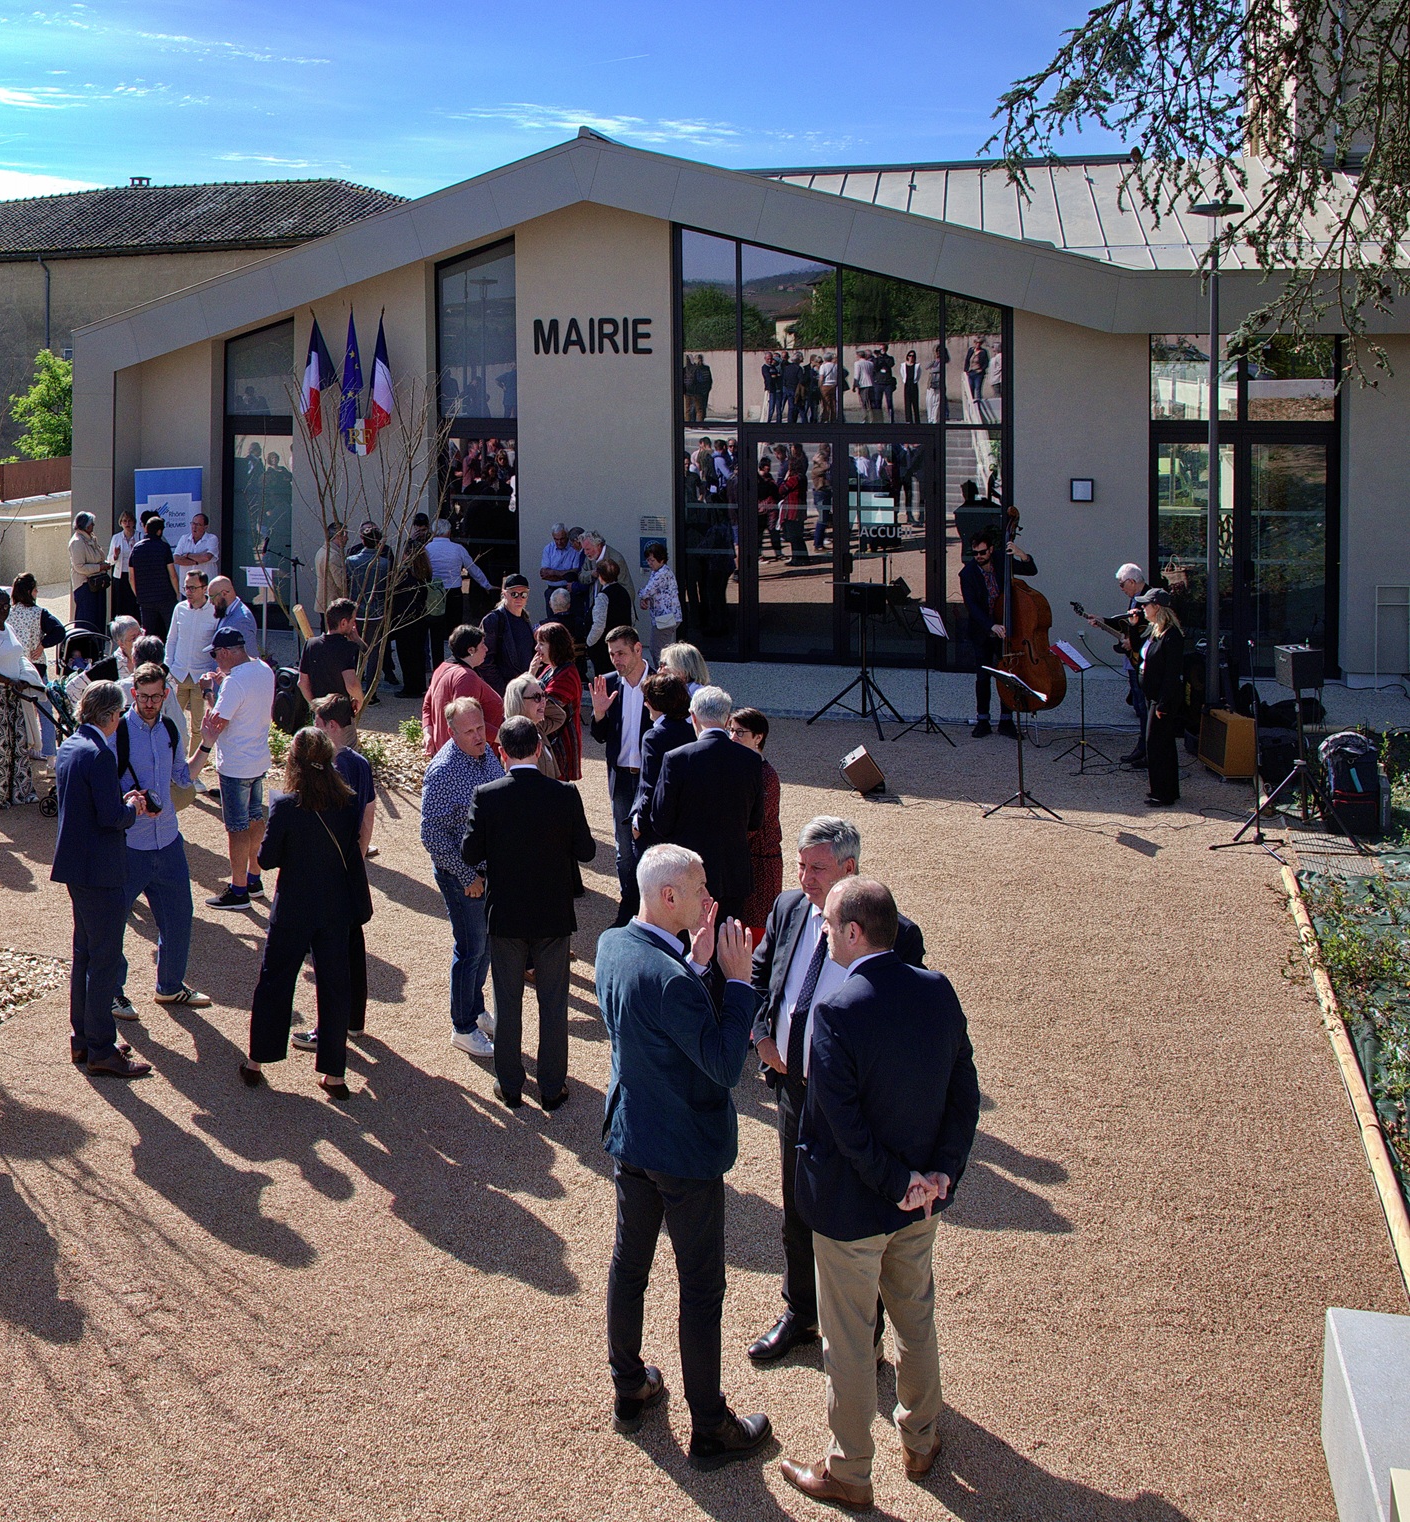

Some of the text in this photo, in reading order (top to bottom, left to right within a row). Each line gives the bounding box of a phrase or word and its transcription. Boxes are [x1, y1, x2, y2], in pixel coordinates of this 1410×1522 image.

[533, 317, 653, 355] MAIRIE
[347, 428, 373, 445] RF
[860, 526, 915, 538] ACCUEIL
